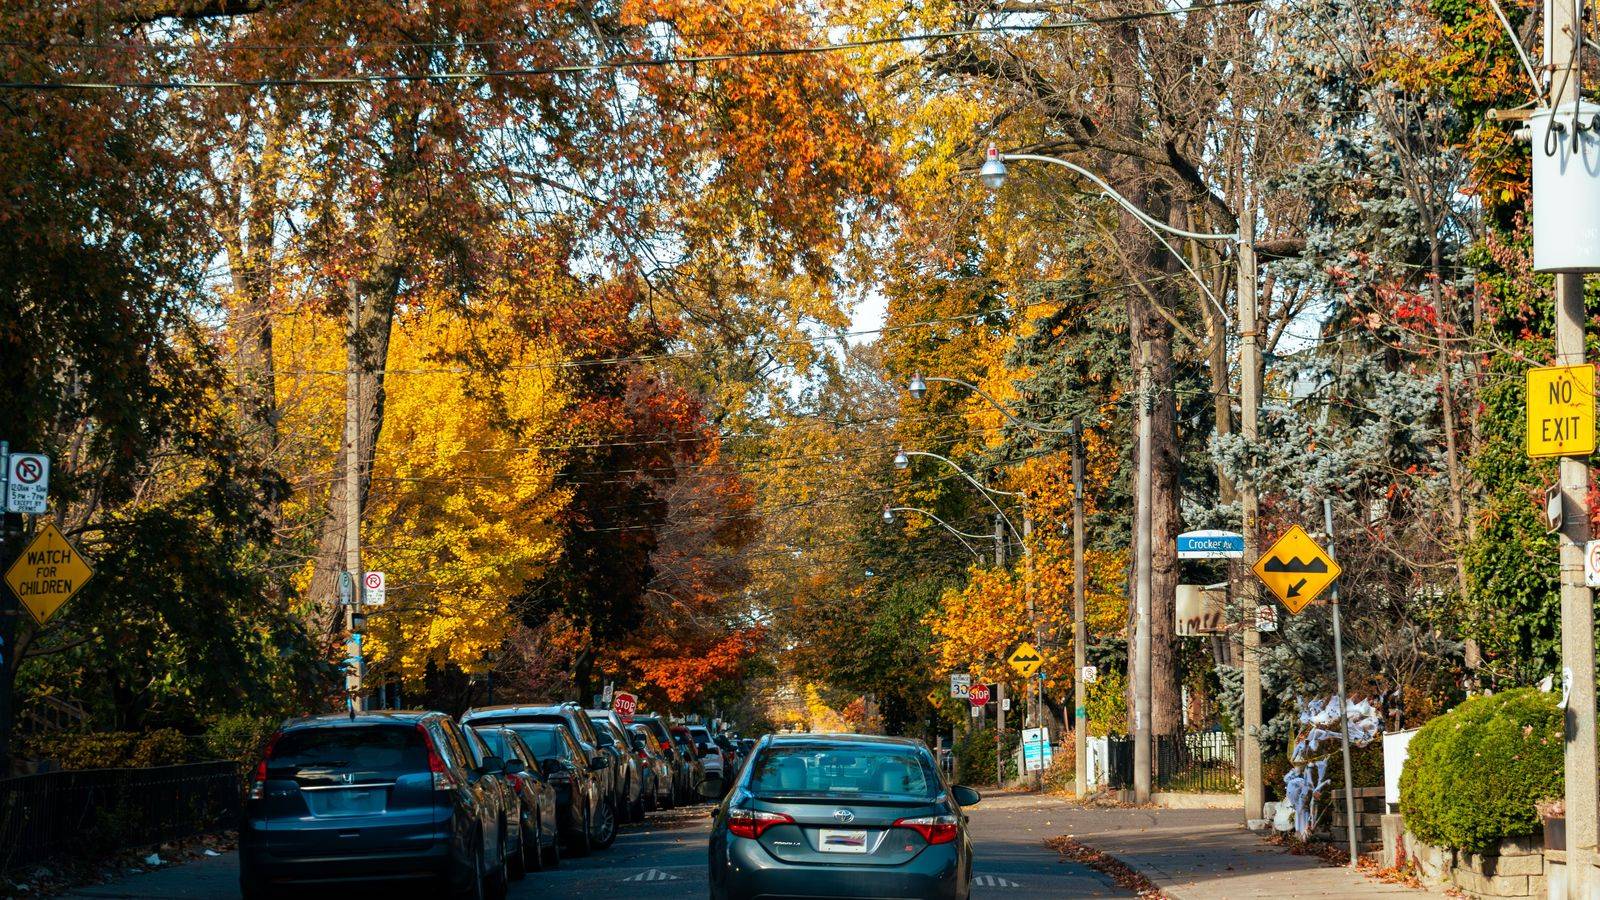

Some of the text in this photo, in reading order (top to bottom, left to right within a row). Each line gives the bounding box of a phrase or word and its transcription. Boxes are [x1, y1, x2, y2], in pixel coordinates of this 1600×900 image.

[1549, 380, 1572, 405] NO
[1542, 416, 1580, 442] EXIT
[1188, 539, 1221, 549] Crocker
[27, 550, 71, 565] WATCH
[36, 566, 57, 578] FOR
[19, 579, 72, 596] CHILDREN
[953, 684, 968, 695] 30
[969, 690, 989, 700] STOP
[616, 698, 636, 712] STOP
